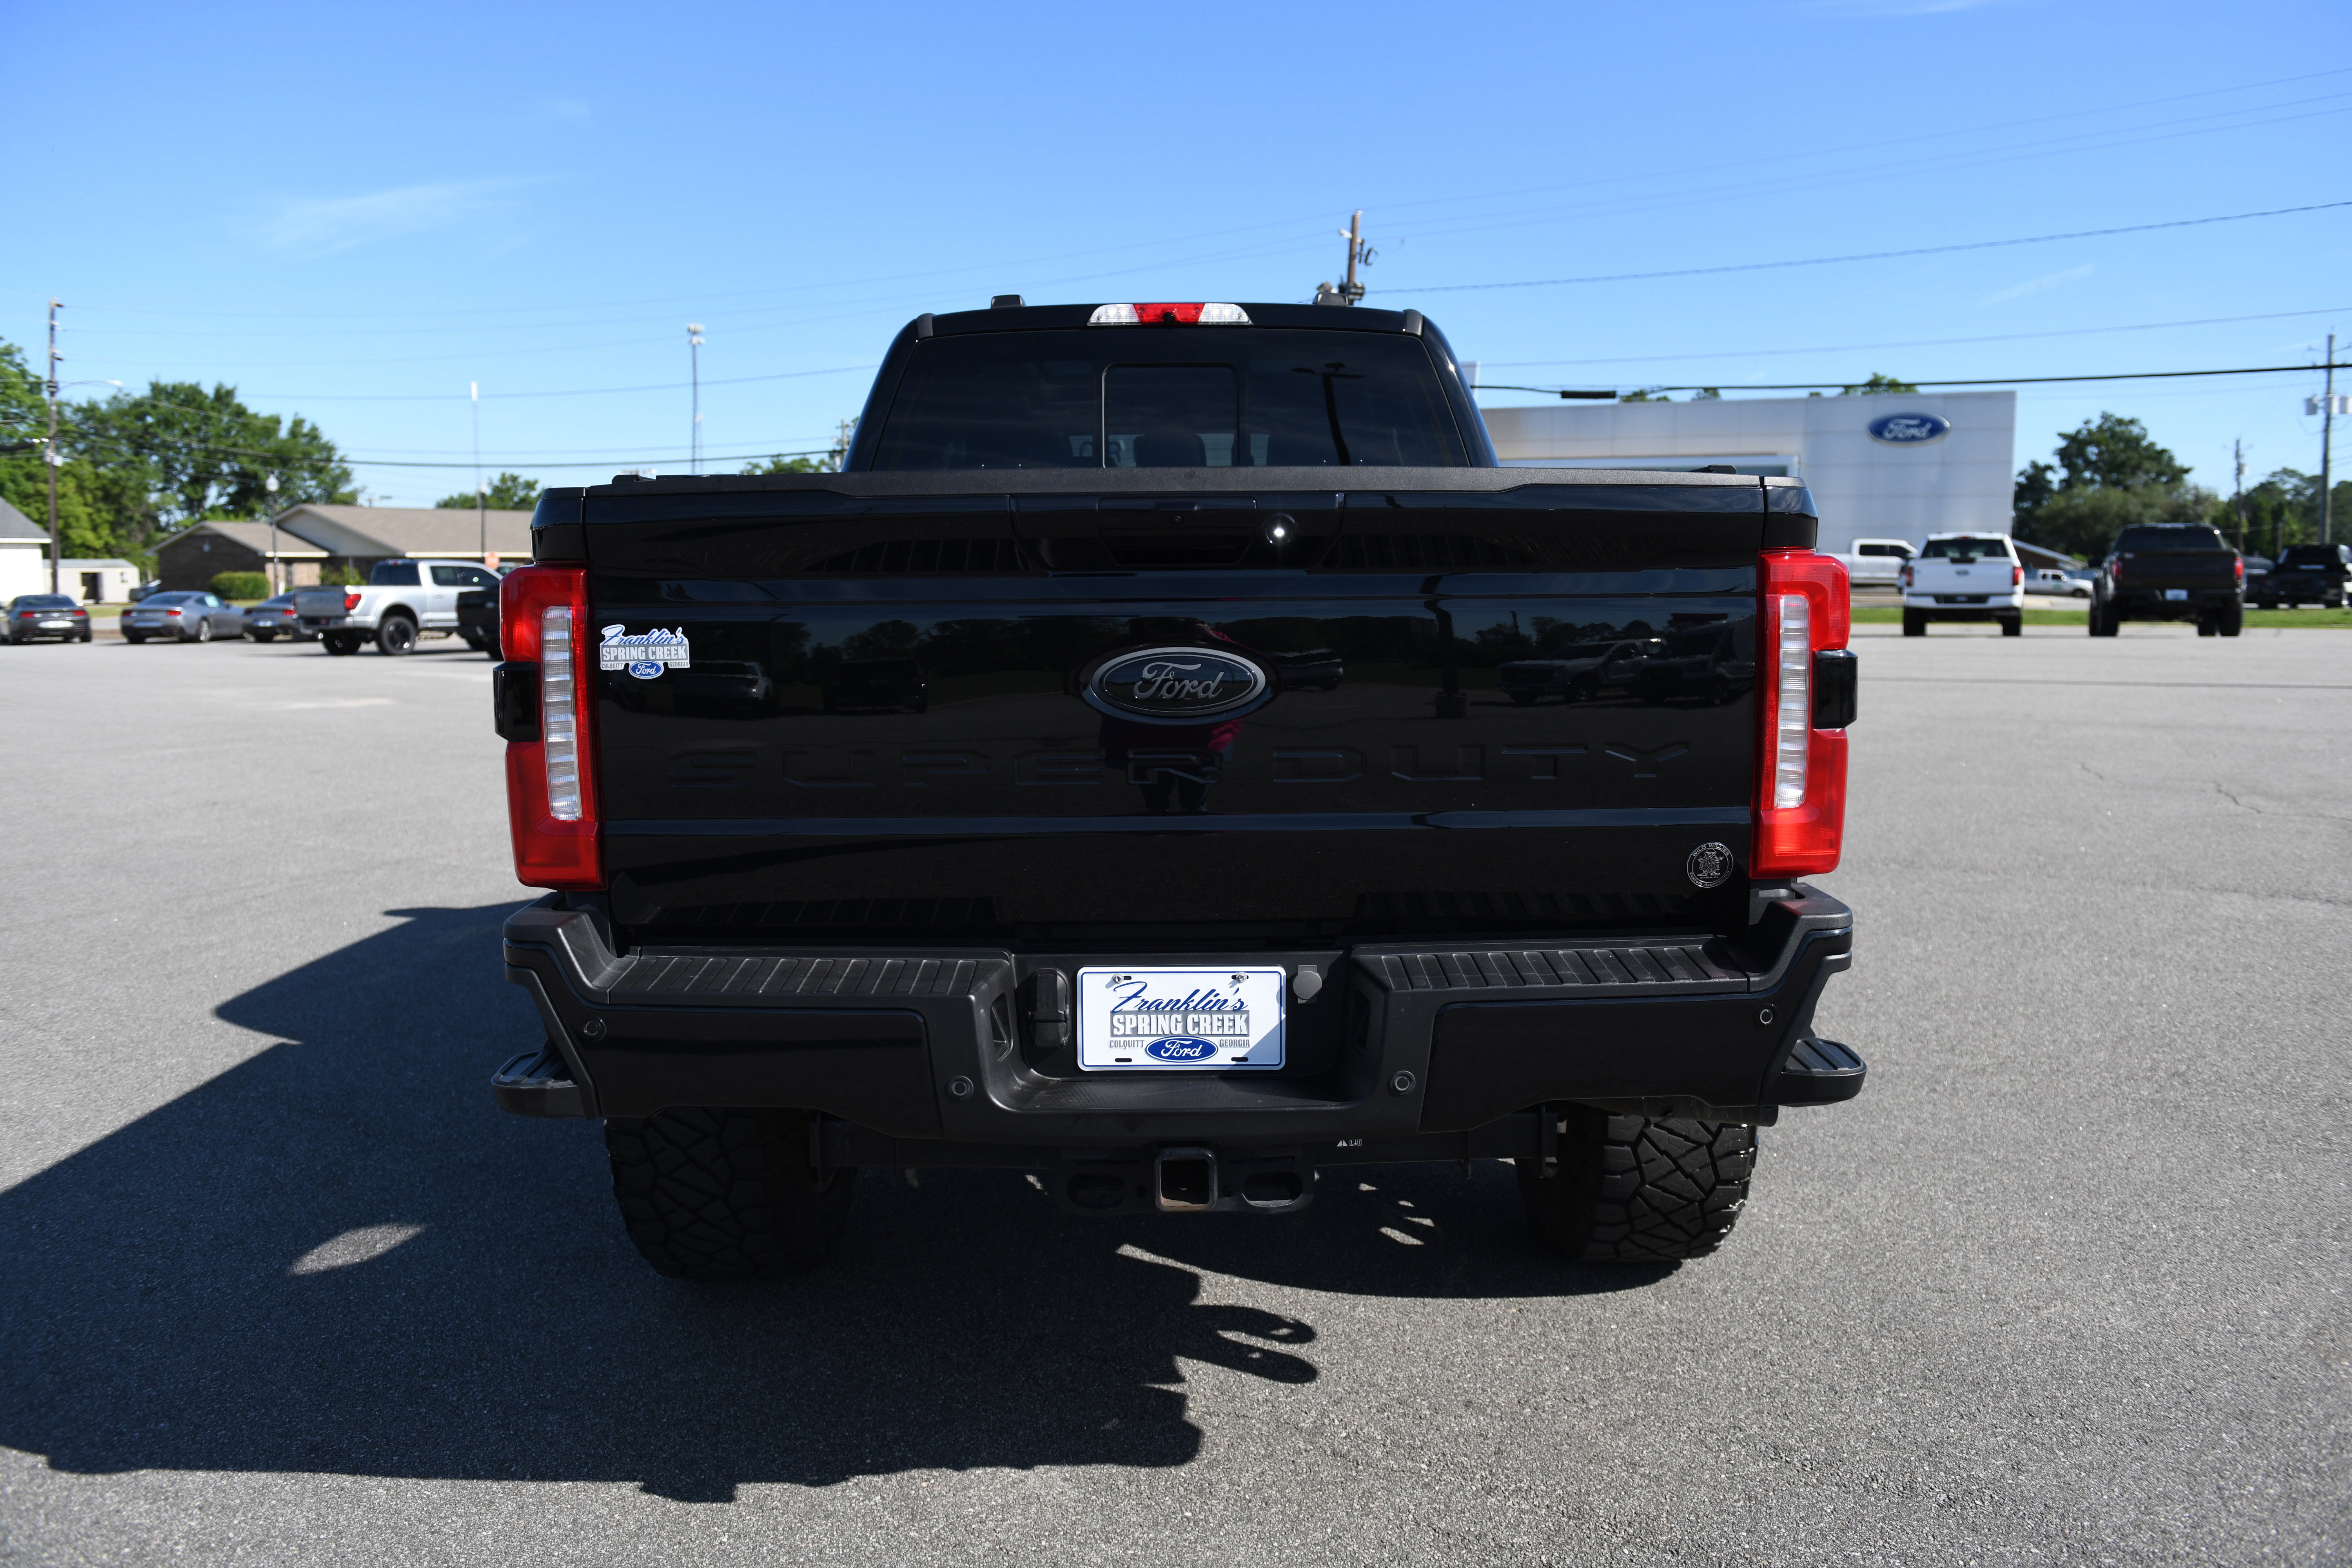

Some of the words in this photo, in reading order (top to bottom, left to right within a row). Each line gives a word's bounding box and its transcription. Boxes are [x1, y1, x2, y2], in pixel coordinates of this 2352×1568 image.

[1883, 419, 1932, 439] Ford
[602, 626, 686, 647] Franklin's
[602, 646, 646, 661] SPRING
[648, 646, 687, 659] CREEK
[636, 662, 657, 675] Ford
[1133, 662, 1225, 699] Ford
[670, 748, 1223, 787] SUPER
[1272, 742, 1690, 783] DUTY
[1692, 845, 1706, 857] WILD
[1708, 844, 1730, 856] WILLIES
[1689, 872, 1703, 885] Custom
[1113, 981, 1248, 1013] Franklin's
[1113, 1014, 1183, 1036] SPRING
[1186, 1013, 1248, 1035] CREEK
[1109, 1039, 1145, 1049] COLQUITT
[1160, 1040, 1203, 1057] Ford
[1219, 1038, 1250, 1047] GEORGIA
